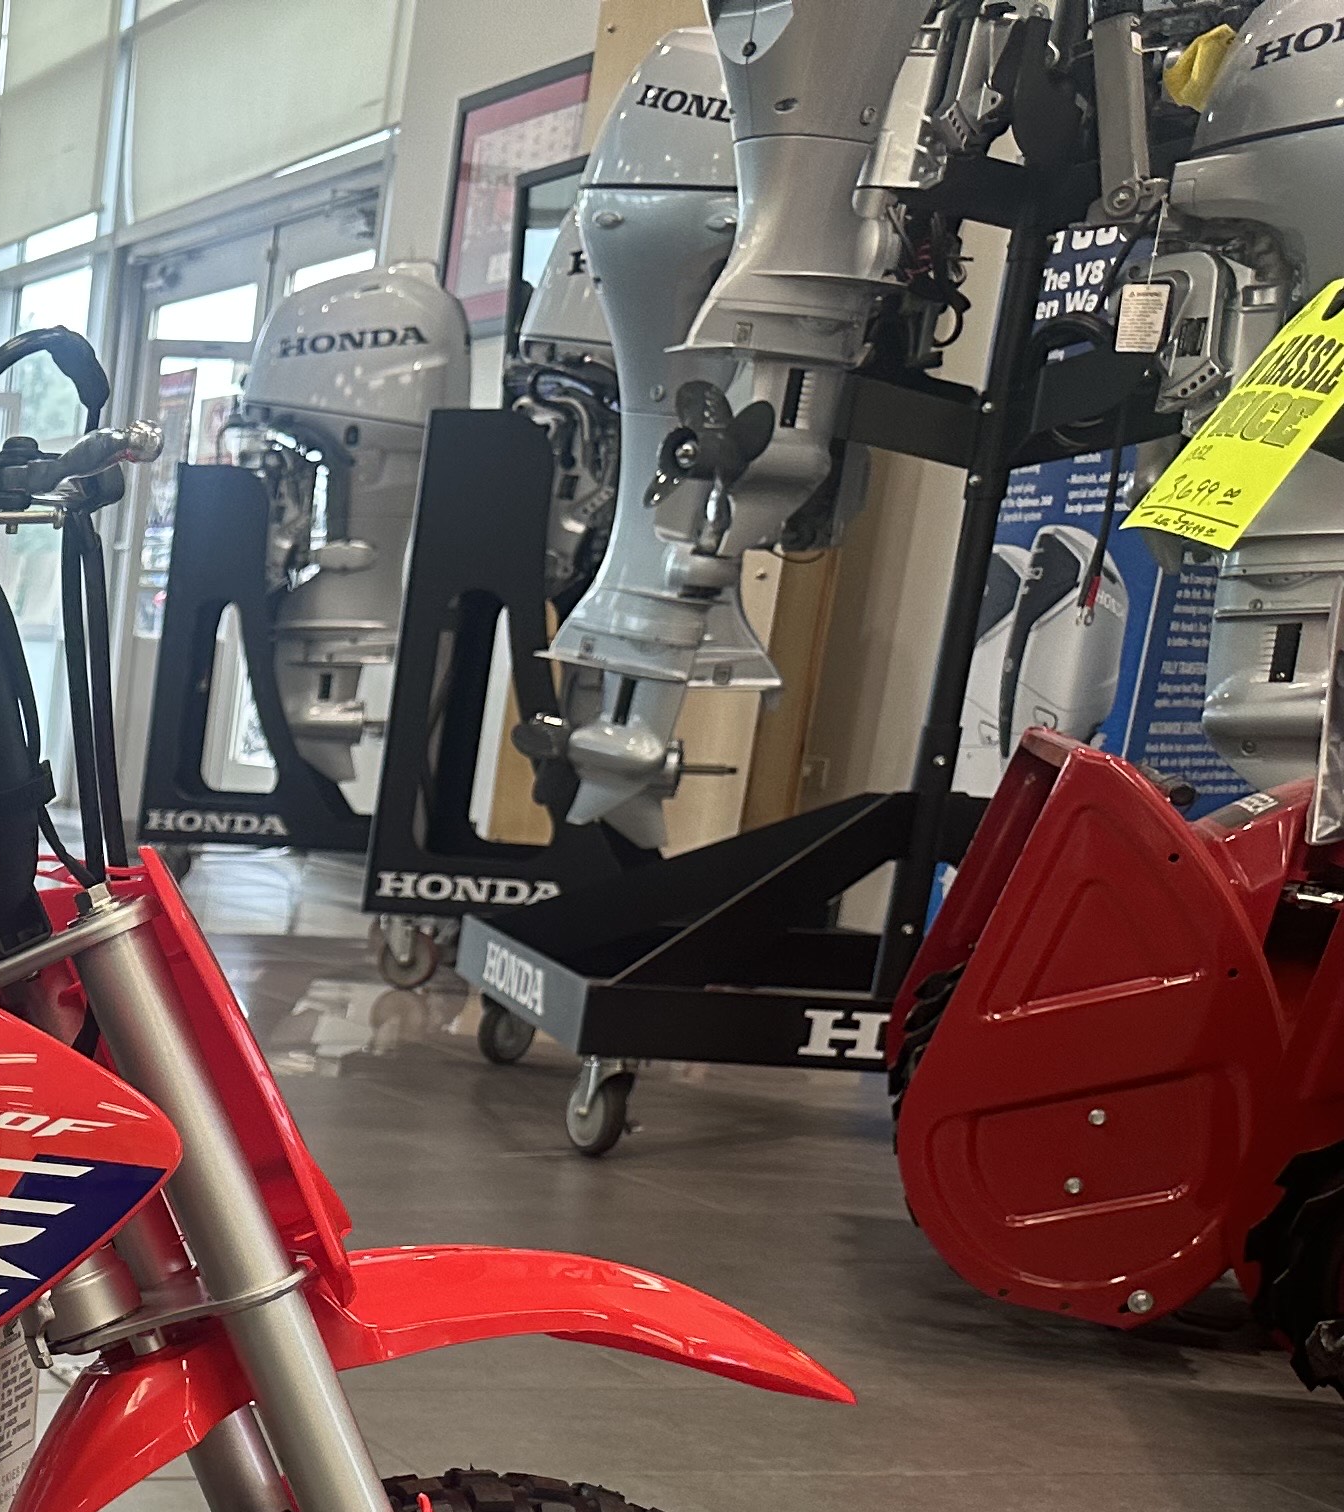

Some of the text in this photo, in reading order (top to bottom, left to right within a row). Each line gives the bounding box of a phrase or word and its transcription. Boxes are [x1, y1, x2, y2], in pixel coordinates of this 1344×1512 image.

[636, 84, 731, 123] HON
[278, 326, 429, 358] HONDA
[145, 808, 290, 837] HONDA
[376, 871, 562, 906] HONDA
[482, 941, 545, 1017] HONDA
